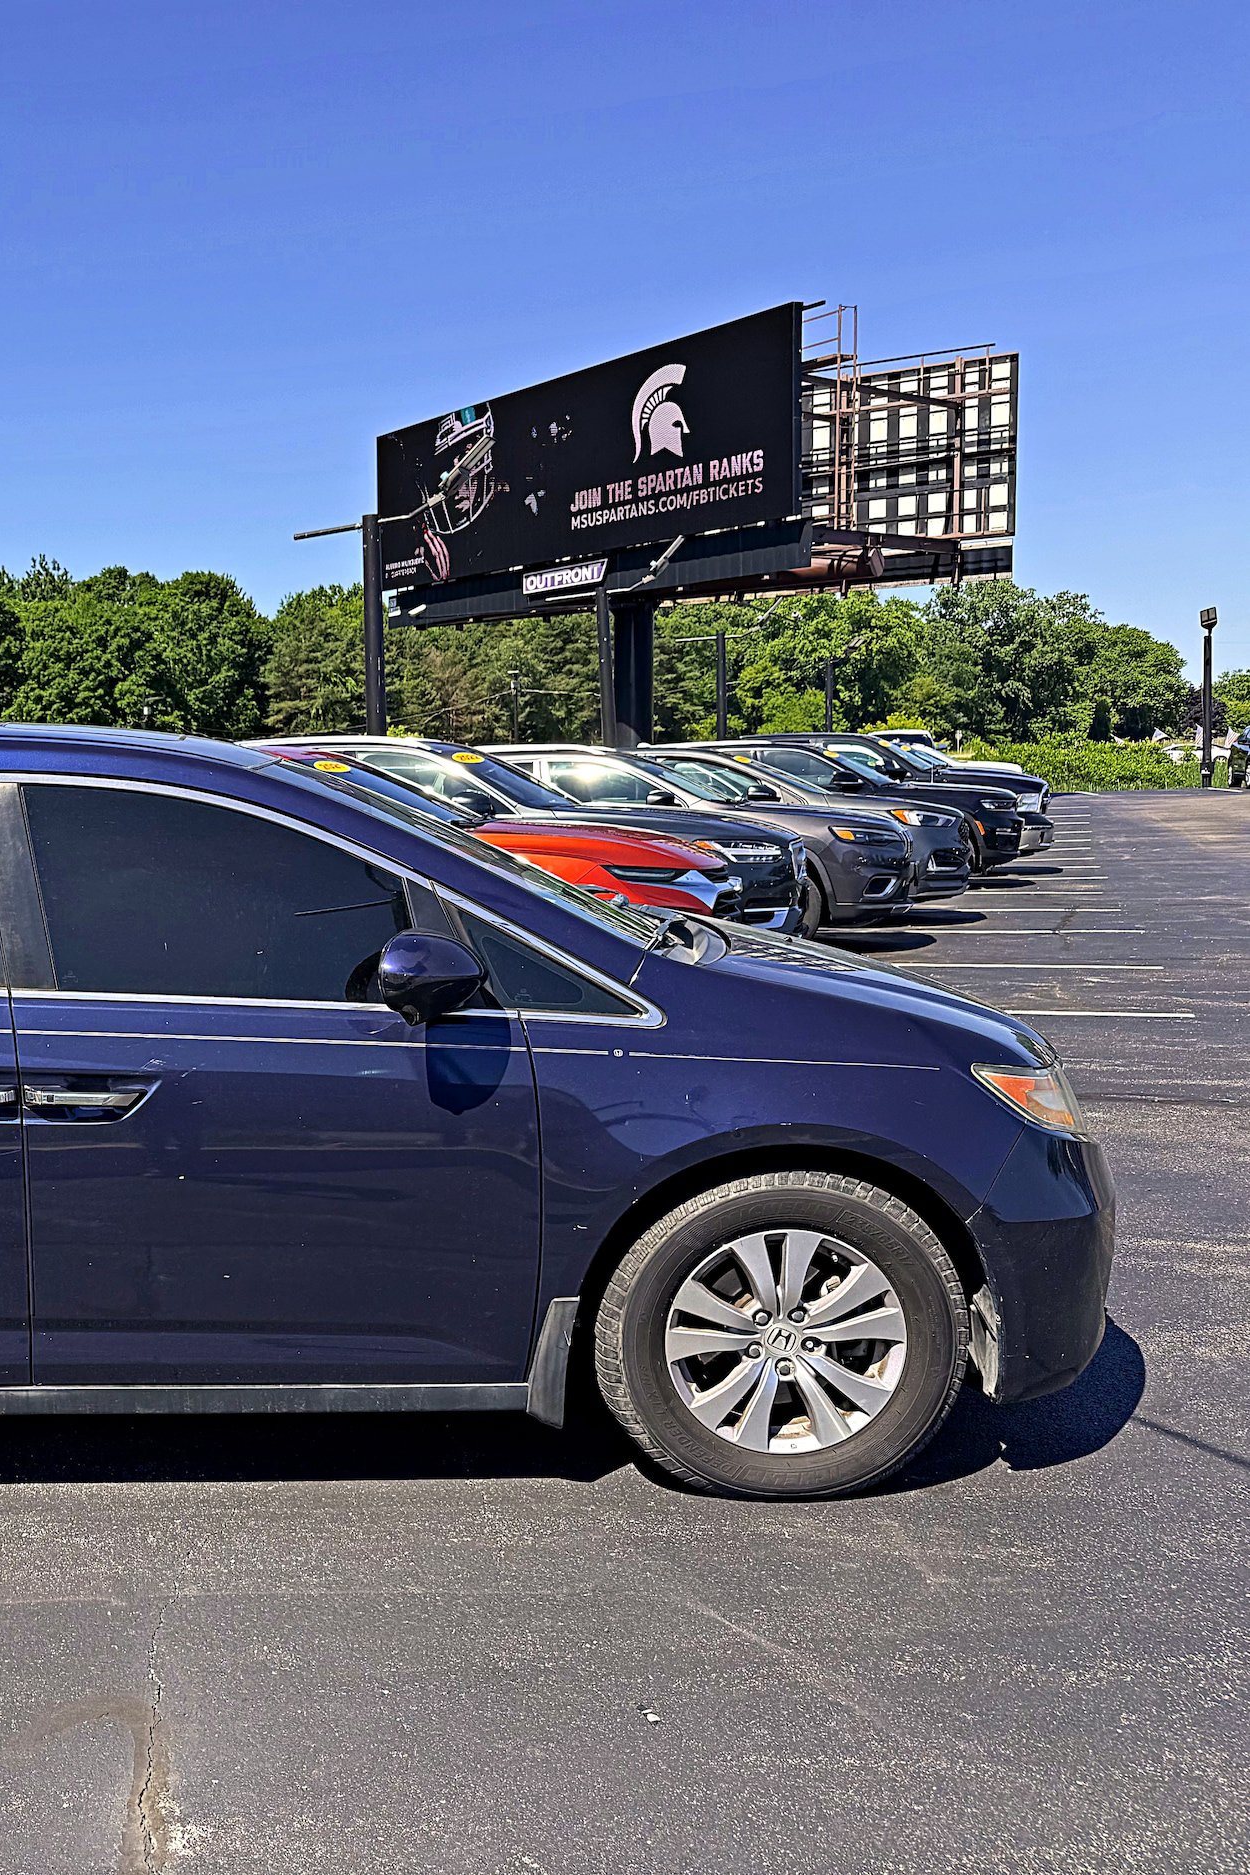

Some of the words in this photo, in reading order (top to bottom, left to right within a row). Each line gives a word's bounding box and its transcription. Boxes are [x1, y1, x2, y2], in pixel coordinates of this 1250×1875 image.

[570, 487, 602, 512] JOIN
[606, 477, 633, 504] THE
[637, 463, 704, 498] SPARTAN
[709, 449, 764, 482] RANKS
[571, 477, 764, 530] MSUSPARTANS.COM/FBTICKETS
[526, 562, 602, 591] OUTFRONT
[717, 1202, 837, 1232] MICHELIN
[662, 1419, 735, 1475] DEFENDER
